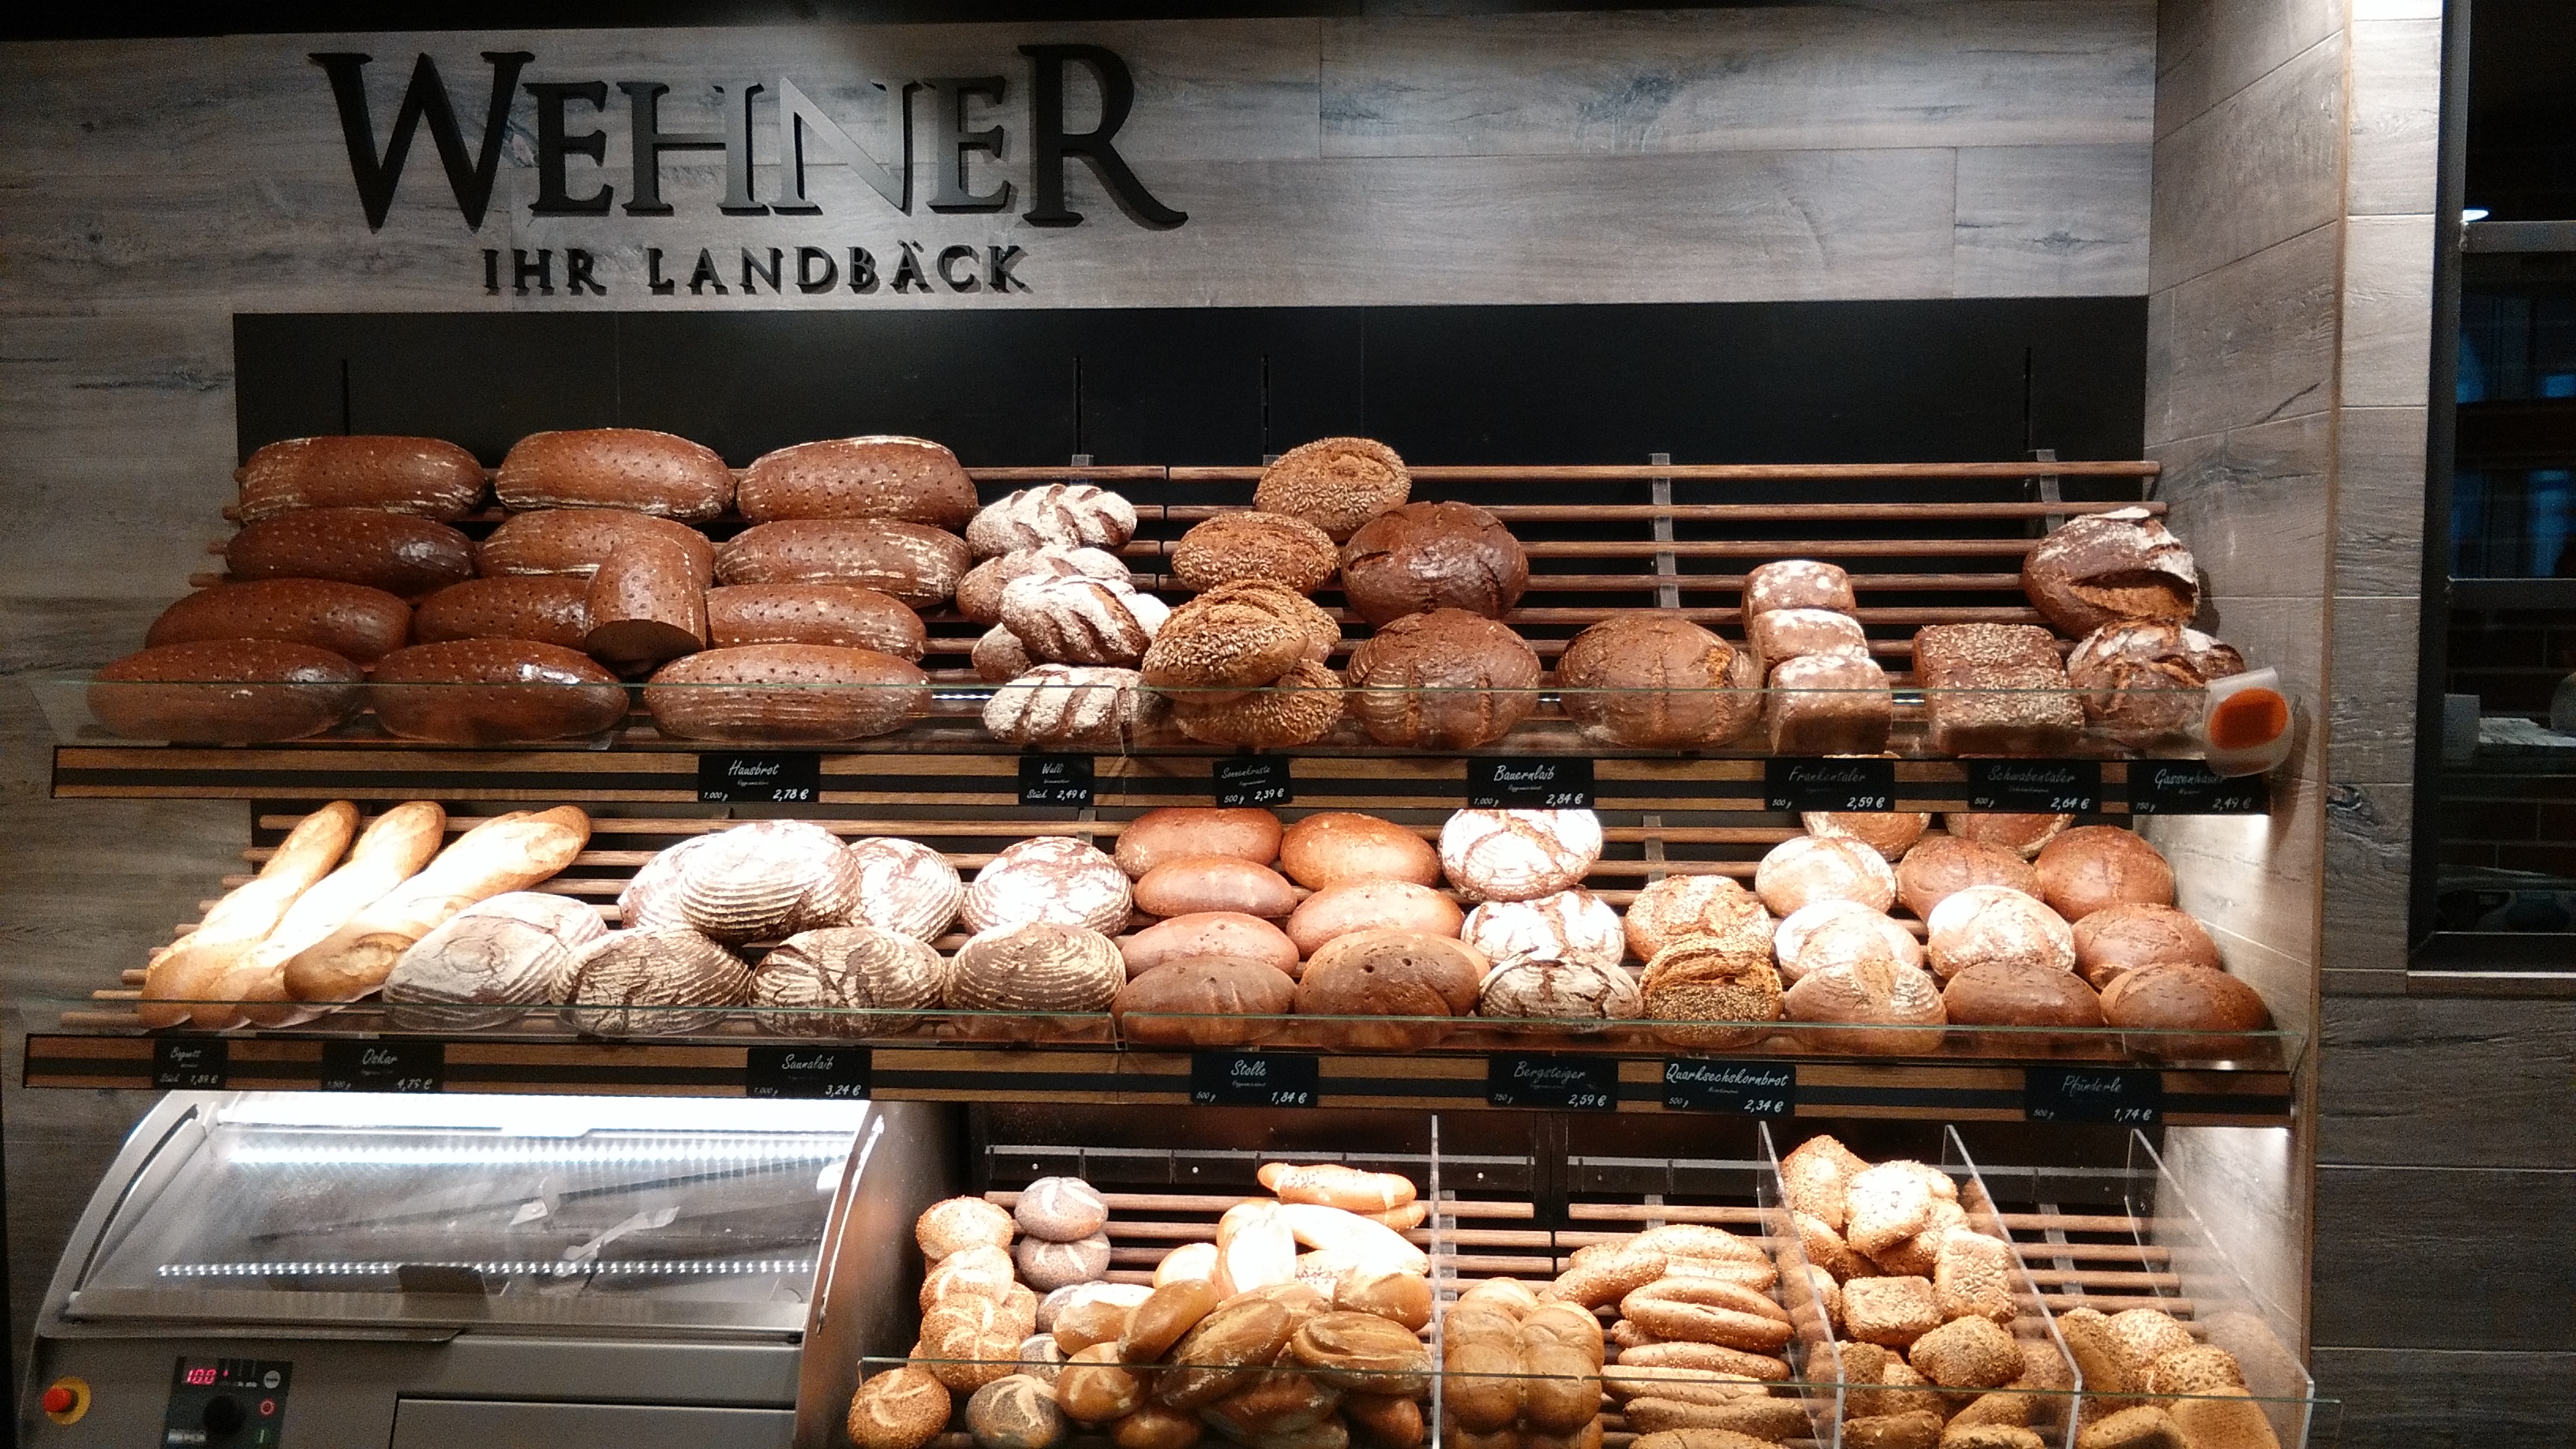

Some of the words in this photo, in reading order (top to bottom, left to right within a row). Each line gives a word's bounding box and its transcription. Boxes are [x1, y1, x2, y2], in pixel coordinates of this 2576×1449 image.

[308, 43, 1189, 234] WEHNER
[481, 247, 606, 296] IHR
[646, 239, 1031, 297] LANDBÄCK
[728, 759, 780, 776] Hausbrot
[1042, 763, 1064, 774] Walli
[1493, 764, 1555, 781] Bauernlaib
[1788, 766, 1866, 781] Frankentaler
[1987, 765, 2076, 783] Schwabentaler
[773, 788, 797, 802] 2,78
[799, 788, 809, 799] €
[1027, 789, 1048, 799] Stück
[1057, 789, 1077, 801] 2,49
[1080, 789, 1087, 799] €
[1238, 796, 1245, 804] g
[1254, 789, 1275, 801] 2,39
[1277, 788, 1284, 797] €
[1546, 792, 1572, 807] 2,84
[1574, 792, 1584, 804] €
[1847, 797, 1873, 810] 2,59
[1876, 797, 1885, 808] €
[2050, 797, 2077, 811] 2,64
[2080, 798, 2090, 810] €
[2212, 797, 2239, 811] 2,49
[2243, 797, 2252, 809] €
[1230, 1059, 1267, 1076] Stolle
[1514, 1061, 1586, 1084] Bergsteiger
[1666, 1063, 1789, 1087] Quarksechskornbrot
[825, 1084, 849, 1097] 3,24
[852, 1084, 861, 1096] €
[2061, 1075, 2122, 1097] Pfänderle
[1196, 1091, 1210, 1099] 500
[1271, 1091, 1296, 1105] 1,84
[1297, 1091, 1308, 1104] €
[1568, 1094, 1594, 1107] 2,59
[1597, 1095, 1607, 1106] €
[1683, 1099, 1689, 1108] g
[1744, 1099, 1771, 1113] 2,34
[1774, 1100, 1784, 1112] €
[2114, 1108, 2140, 1122] 1,74
[2143, 1109, 2152, 1121] €
